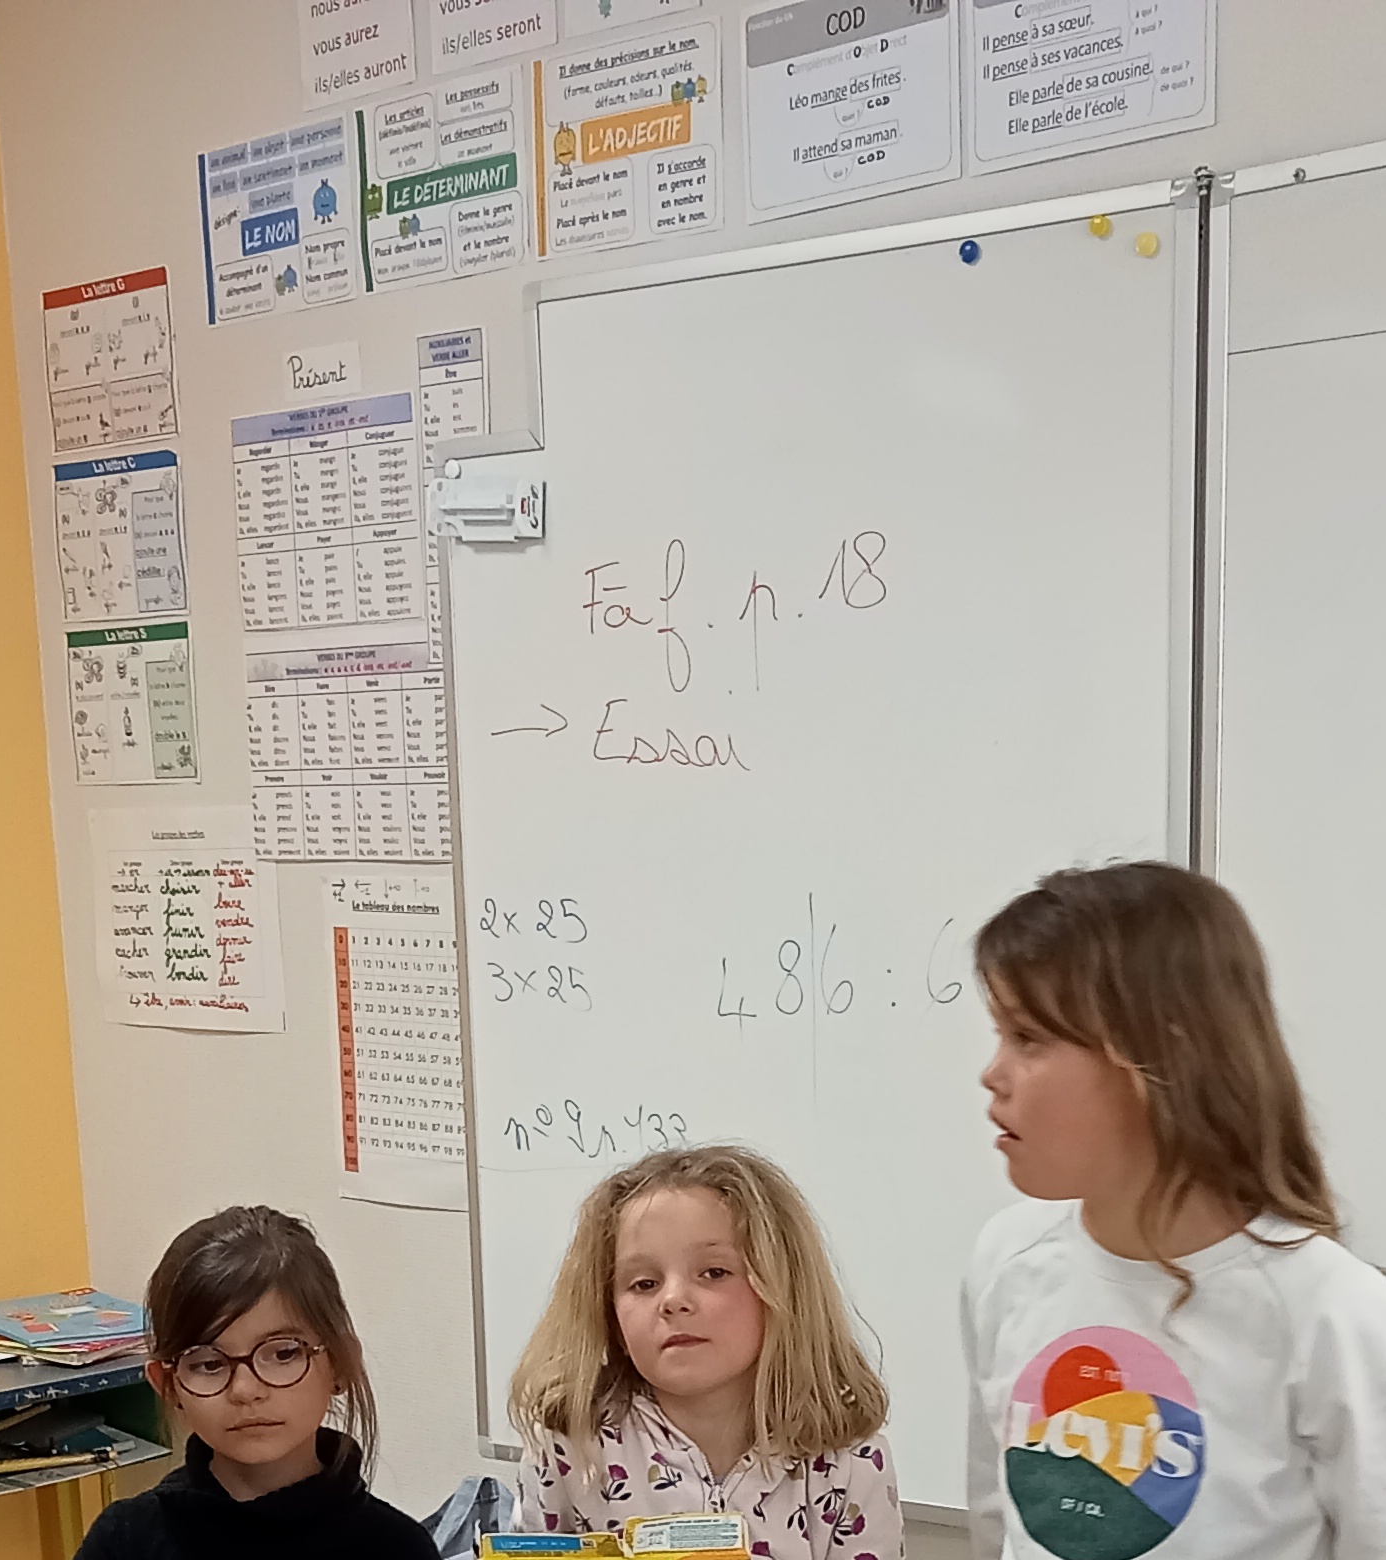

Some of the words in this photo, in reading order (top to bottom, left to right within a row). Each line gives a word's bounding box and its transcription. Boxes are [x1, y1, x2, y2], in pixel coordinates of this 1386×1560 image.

[441, 28, 493, 56] ils/elles
[496, 13, 542, 42] seront
[826, 6, 866, 36] COD
[982, 37, 990, 51] Il
[992, 30, 1029, 51] pense
[1031, 24, 1039, 40] à
[1041, 23, 1056, 38] sa
[1058, 13, 1095, 33] sœur.
[312, 37, 342, 56] vous
[344, 23, 381, 45] aurez
[594, 56, 608, 70] des
[611, 48, 650, 68] précisions
[982, 65, 990, 80] Il
[992, 58, 1028, 80] pense
[1031, 52, 1039, 69] à
[1041, 49, 1061, 66] ses
[1063, 35, 1124, 61] vacances.
[314, 69, 361, 95] ils/elles
[363, 53, 407, 80] auront
[1008, 91, 1029, 107] Elle
[1032, 81, 1064, 104] parle
[1066, 76, 1082, 92] de
[1085, 74, 1099, 90] sa
[1102, 61, 1153, 85] cousine.
[789, 94, 809, 110] Léo
[810, 84, 848, 108] mange
[849, 78, 869, 95] des
[867, 96, 890, 109] COD
[587, 114, 684, 156] L'ADJECTIF
[1008, 119, 1029, 135] Elle
[1032, 109, 1063, 133] parle
[1065, 105, 1082, 122] de
[793, 147, 800, 162] Il
[802, 139, 839, 161] attend
[840, 138, 853, 151] sa
[857, 150, 886, 165] COD
[393, 186, 411, 209] LE
[413, 163, 510, 204] DÉTERMINANT
[670, 178, 694, 195] genre
[674, 192, 704, 206] nombre
[244, 226, 263, 250] LE
[265, 218, 297, 245] NOM
[287, 355, 348, 390] Présent
[818, 531, 888, 609] 18
